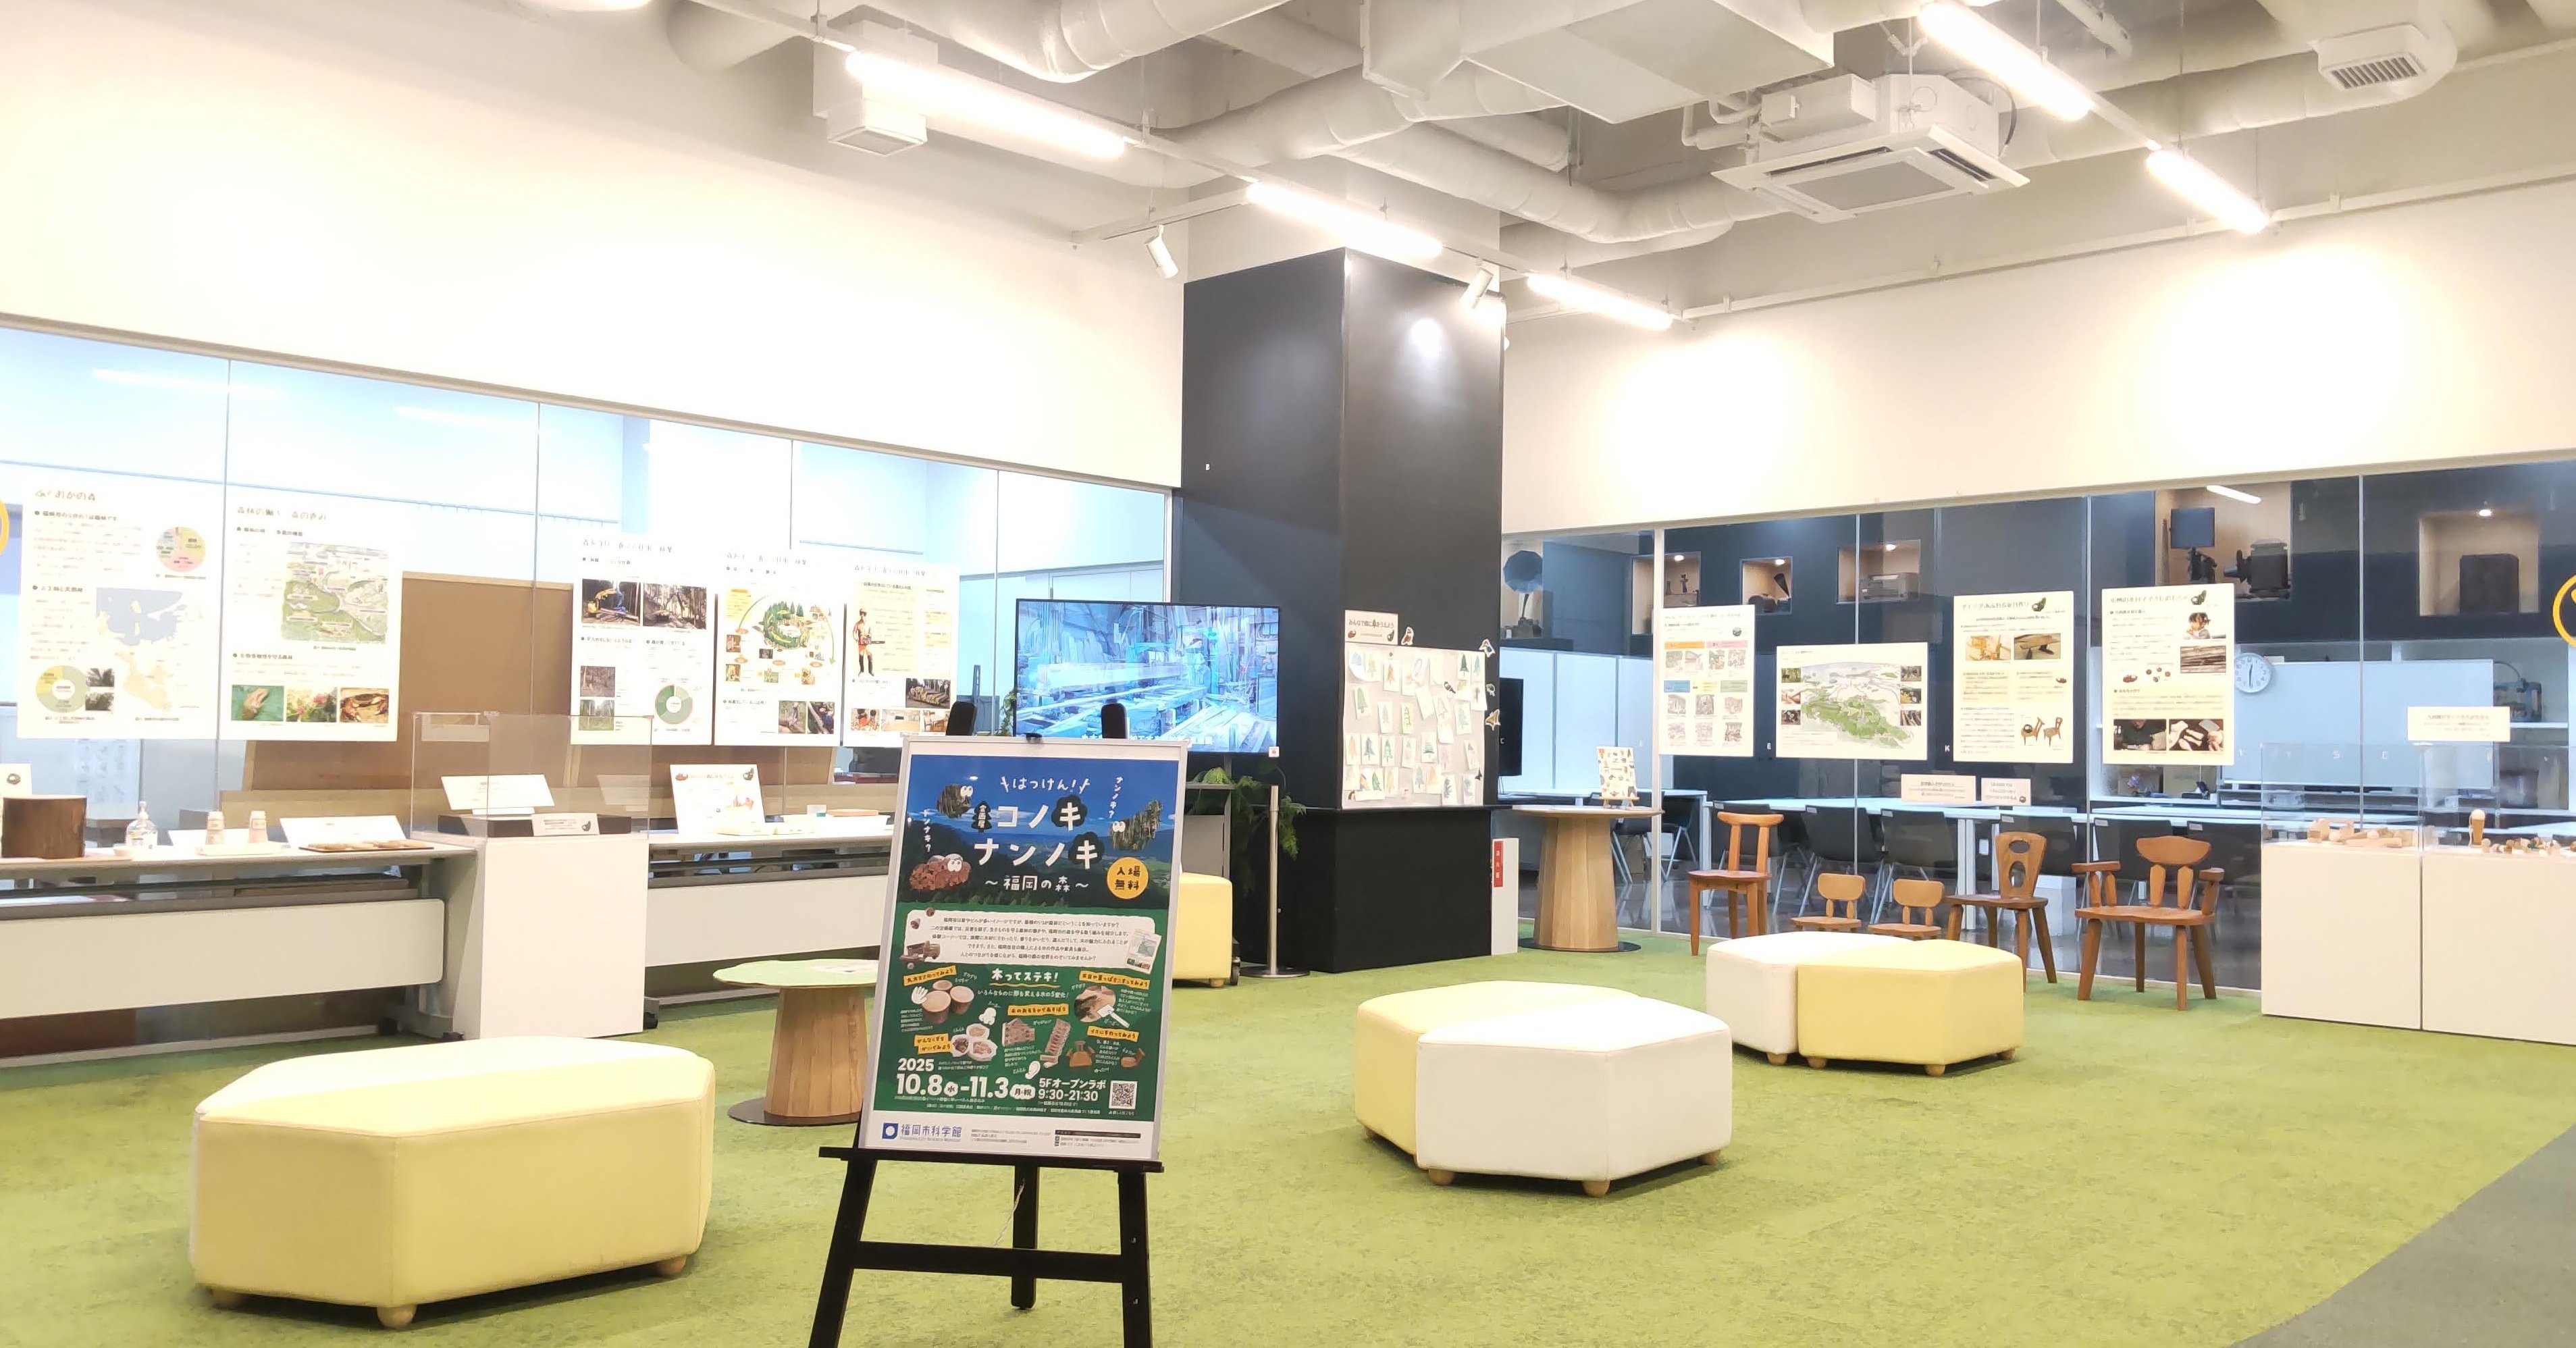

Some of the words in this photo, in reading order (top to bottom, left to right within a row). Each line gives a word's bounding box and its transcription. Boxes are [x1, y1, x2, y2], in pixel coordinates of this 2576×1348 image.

[997, 802, 1082, 831] コノキ
[974, 837, 1099, 870] ナンノキ
[1116, 865, 1140, 877] 入場
[1114, 879, 1140, 891] 無料
[991, 967, 1059, 983] 木ってステキ!
[897, 1058, 935, 1072] 2025
[897, 1073, 943, 1095] 10.8
[1039, 1077, 1107, 1090] 5Fオープンラボ
[1038, 1088, 1099, 1101] 9:30-21:30
[901, 1124, 962, 1138] 福岡市科学館
